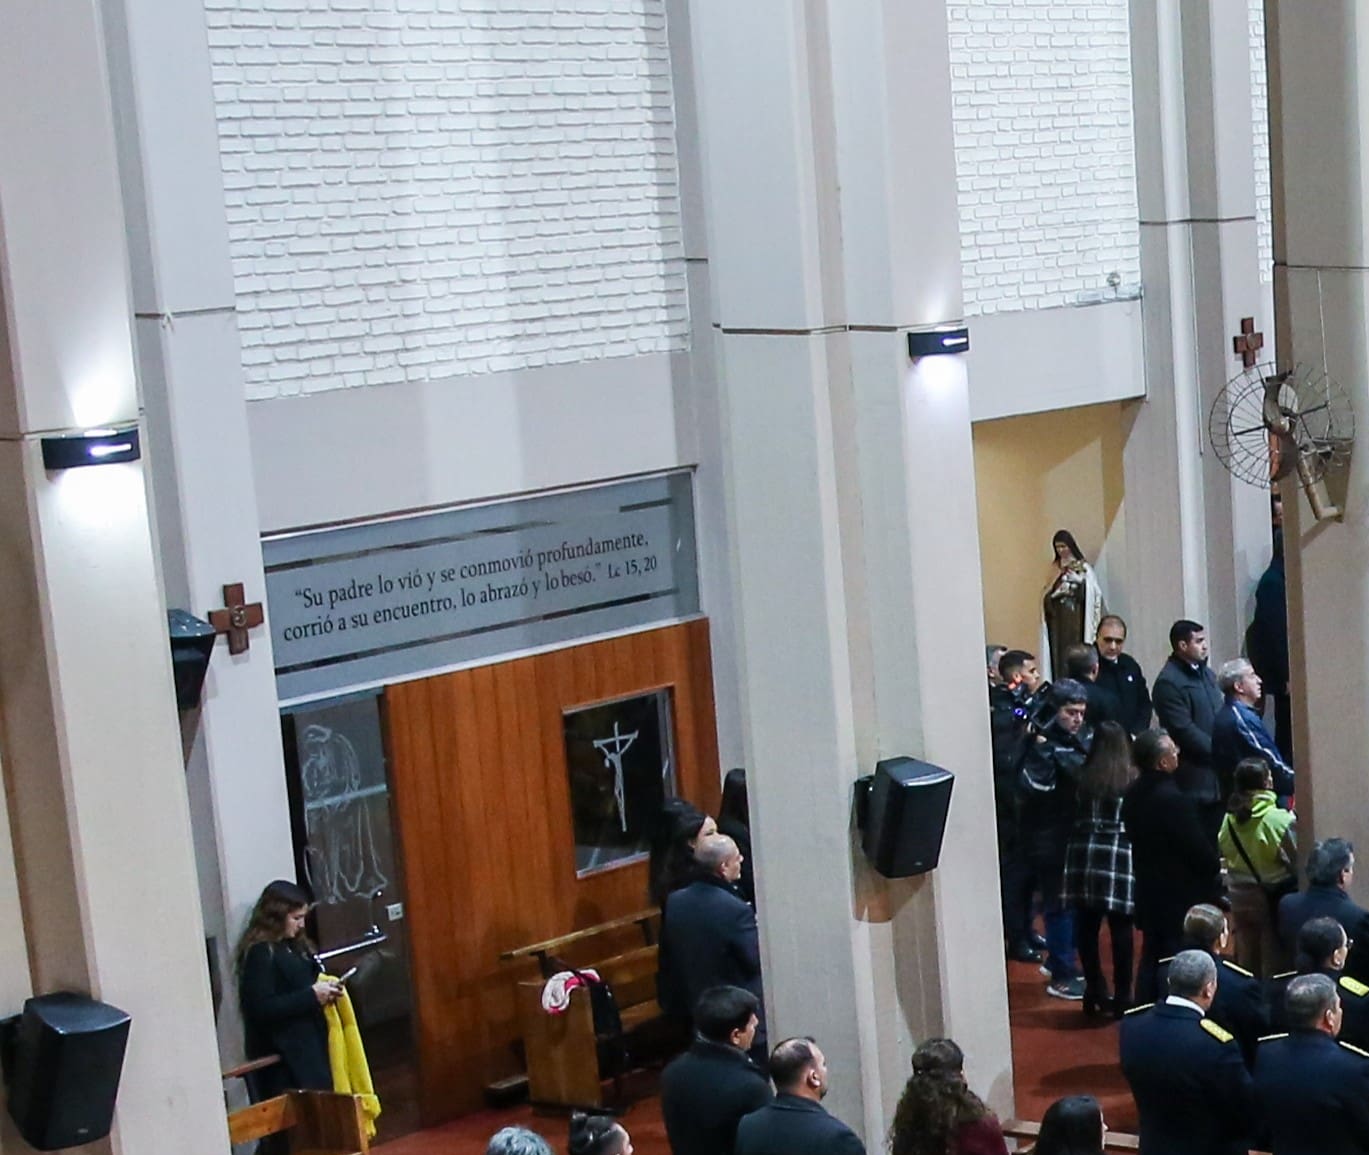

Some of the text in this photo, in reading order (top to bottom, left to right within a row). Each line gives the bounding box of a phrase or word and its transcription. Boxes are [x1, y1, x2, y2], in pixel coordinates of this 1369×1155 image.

[283, 614, 334, 641] corrió
[338, 617, 347, 631] a
[351, 613, 369, 629] su
[373, 597, 457, 624] encuentro,
[460, 588, 476, 608] lo
[480, 577, 528, 604] abrazó
[532, 579, 541, 599] y
[545, 572, 559, 591] lo
[608, 563, 621, 579] Lc
[644, 555, 657, 572] 20
[328, 579, 374, 610] padre
[378, 574, 394, 594] lo
[398, 568, 423, 590] vió
[426, 571, 437, 592] y
[440, 567, 456, 583] se
[460, 548, 534, 579] conmovió
